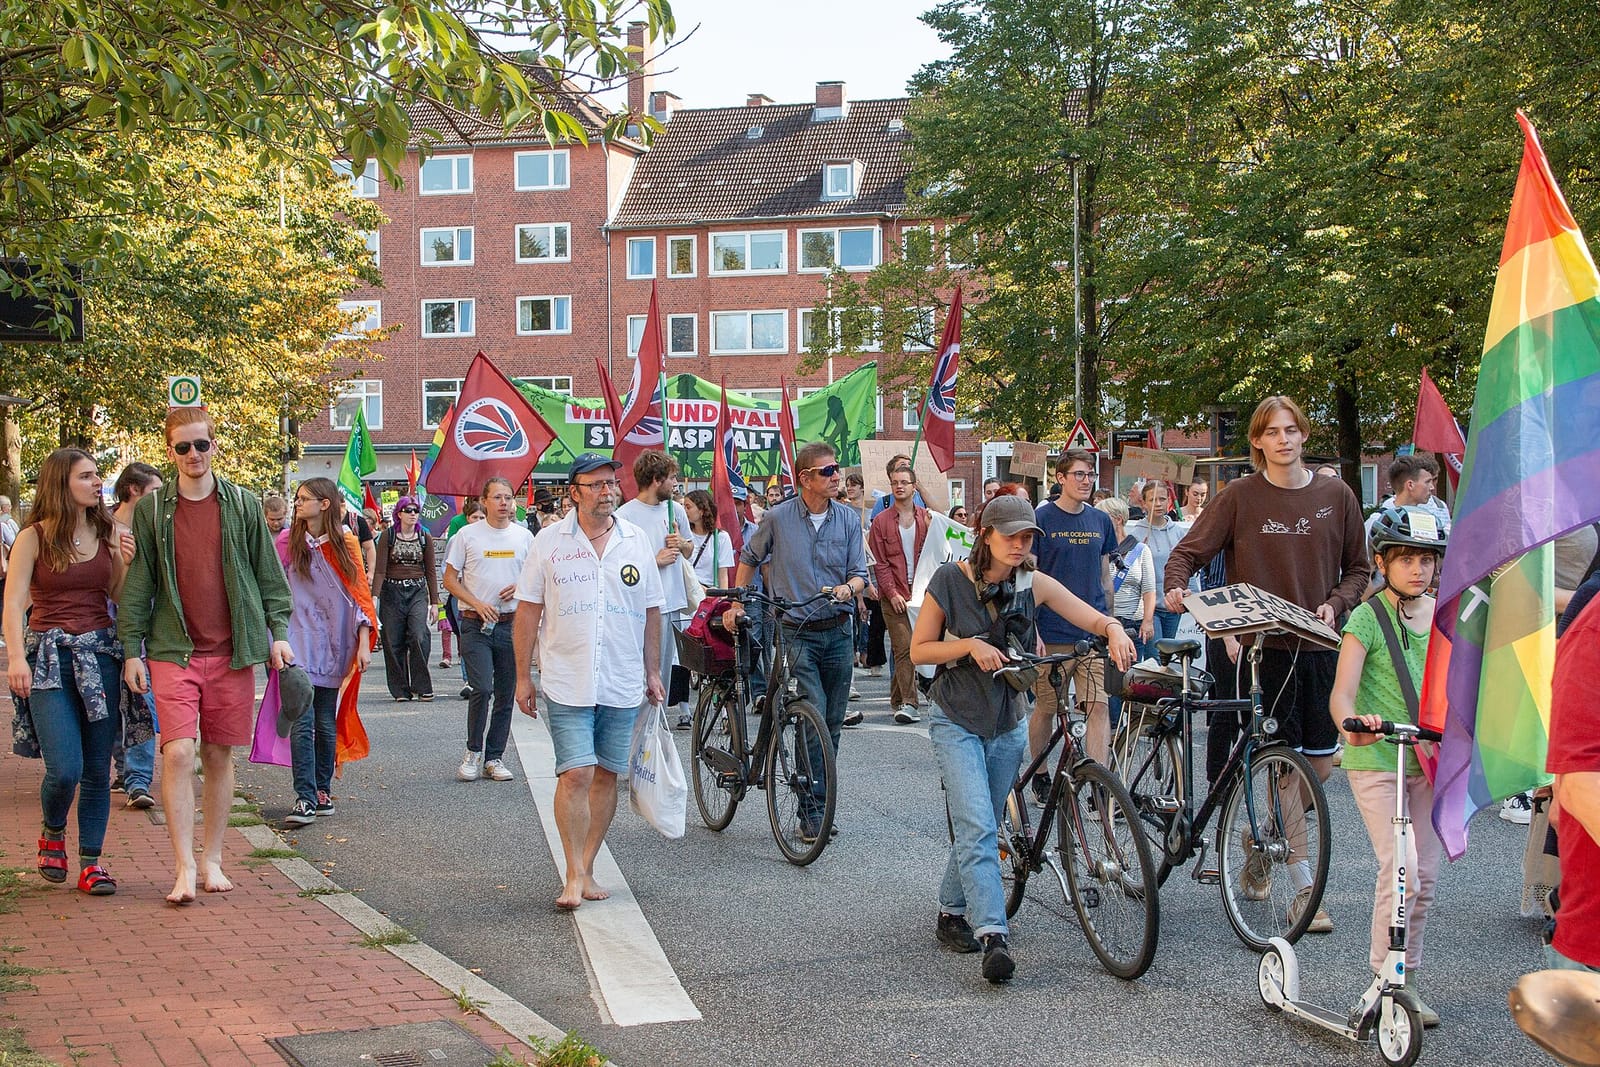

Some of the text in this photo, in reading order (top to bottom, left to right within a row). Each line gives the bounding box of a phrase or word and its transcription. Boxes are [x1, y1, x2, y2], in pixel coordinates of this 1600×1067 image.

[179, 383, 191, 400] H
[668, 402, 719, 423] UND
[730, 408, 782, 428] WAL
[668, 428, 775, 450] ASPALT
